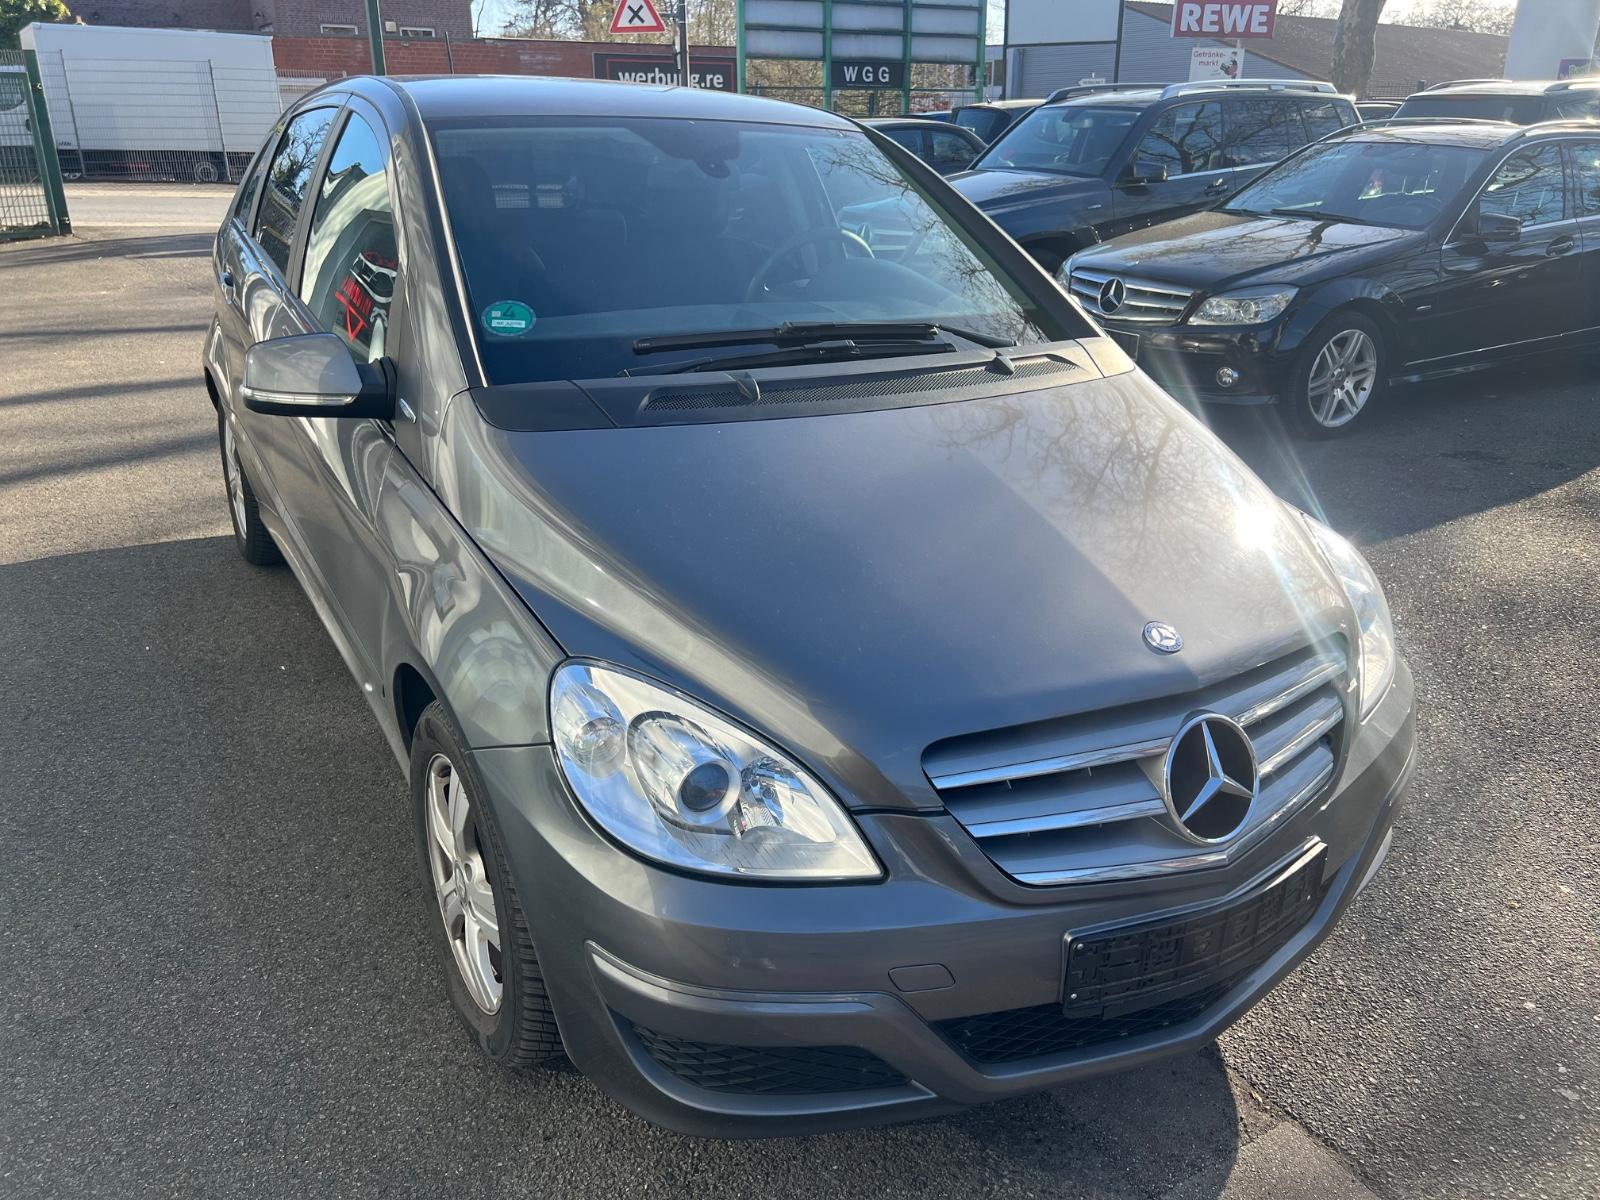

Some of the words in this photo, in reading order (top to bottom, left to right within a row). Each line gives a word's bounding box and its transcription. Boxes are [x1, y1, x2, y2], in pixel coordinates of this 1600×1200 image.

[1180, 3, 1269, 33] REWE
[1193, 49, 1226, 59] Getränke-
[618, 67, 723, 88] werbug.re
